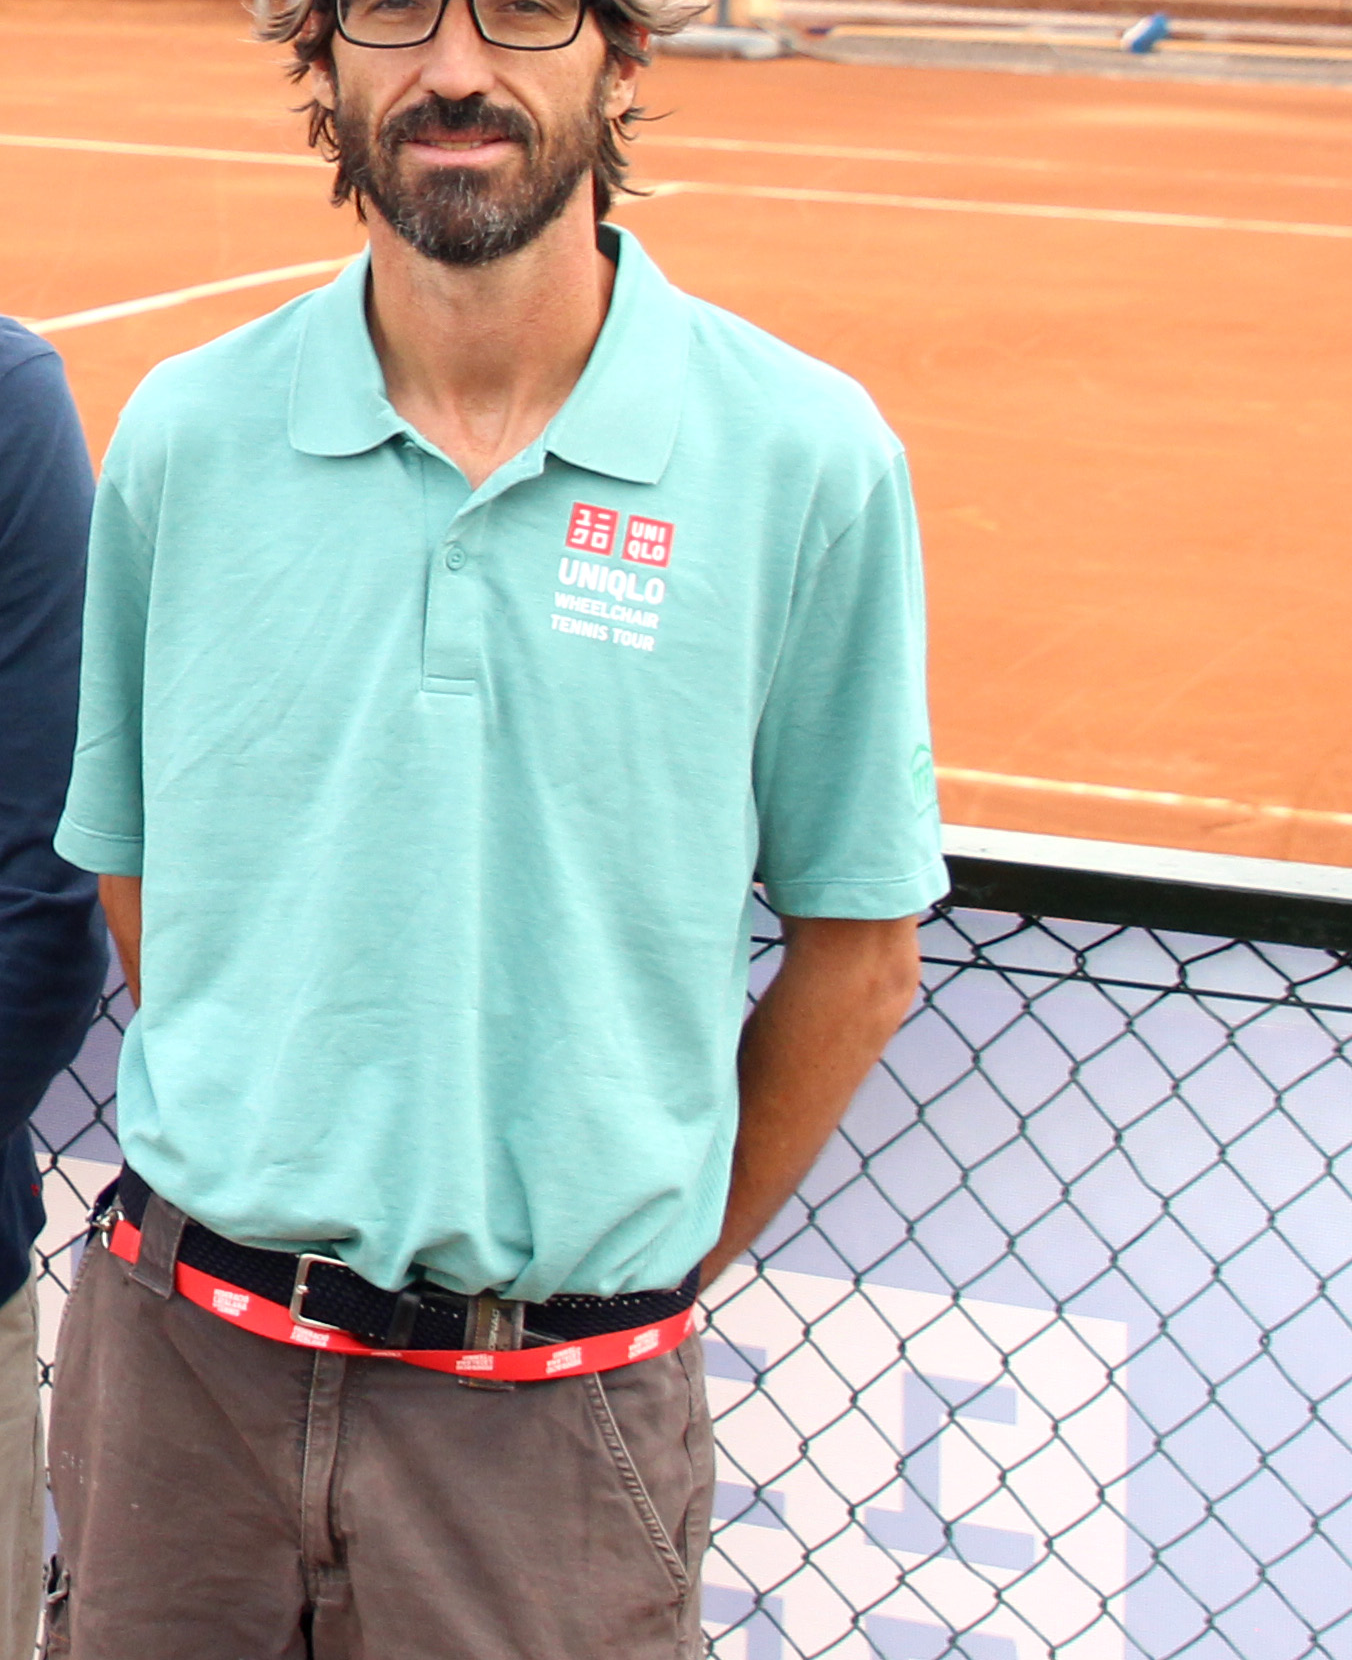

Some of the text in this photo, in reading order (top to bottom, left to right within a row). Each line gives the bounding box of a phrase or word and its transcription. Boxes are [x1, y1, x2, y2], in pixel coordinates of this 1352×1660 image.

[627, 539, 666, 562] QLO
[630, 520, 667, 544] UNI
[557, 556, 666, 606] UNIQLO
[553, 591, 660, 630] WHEELCHAIR
[550, 613, 656, 653] TENNIS TOUR
